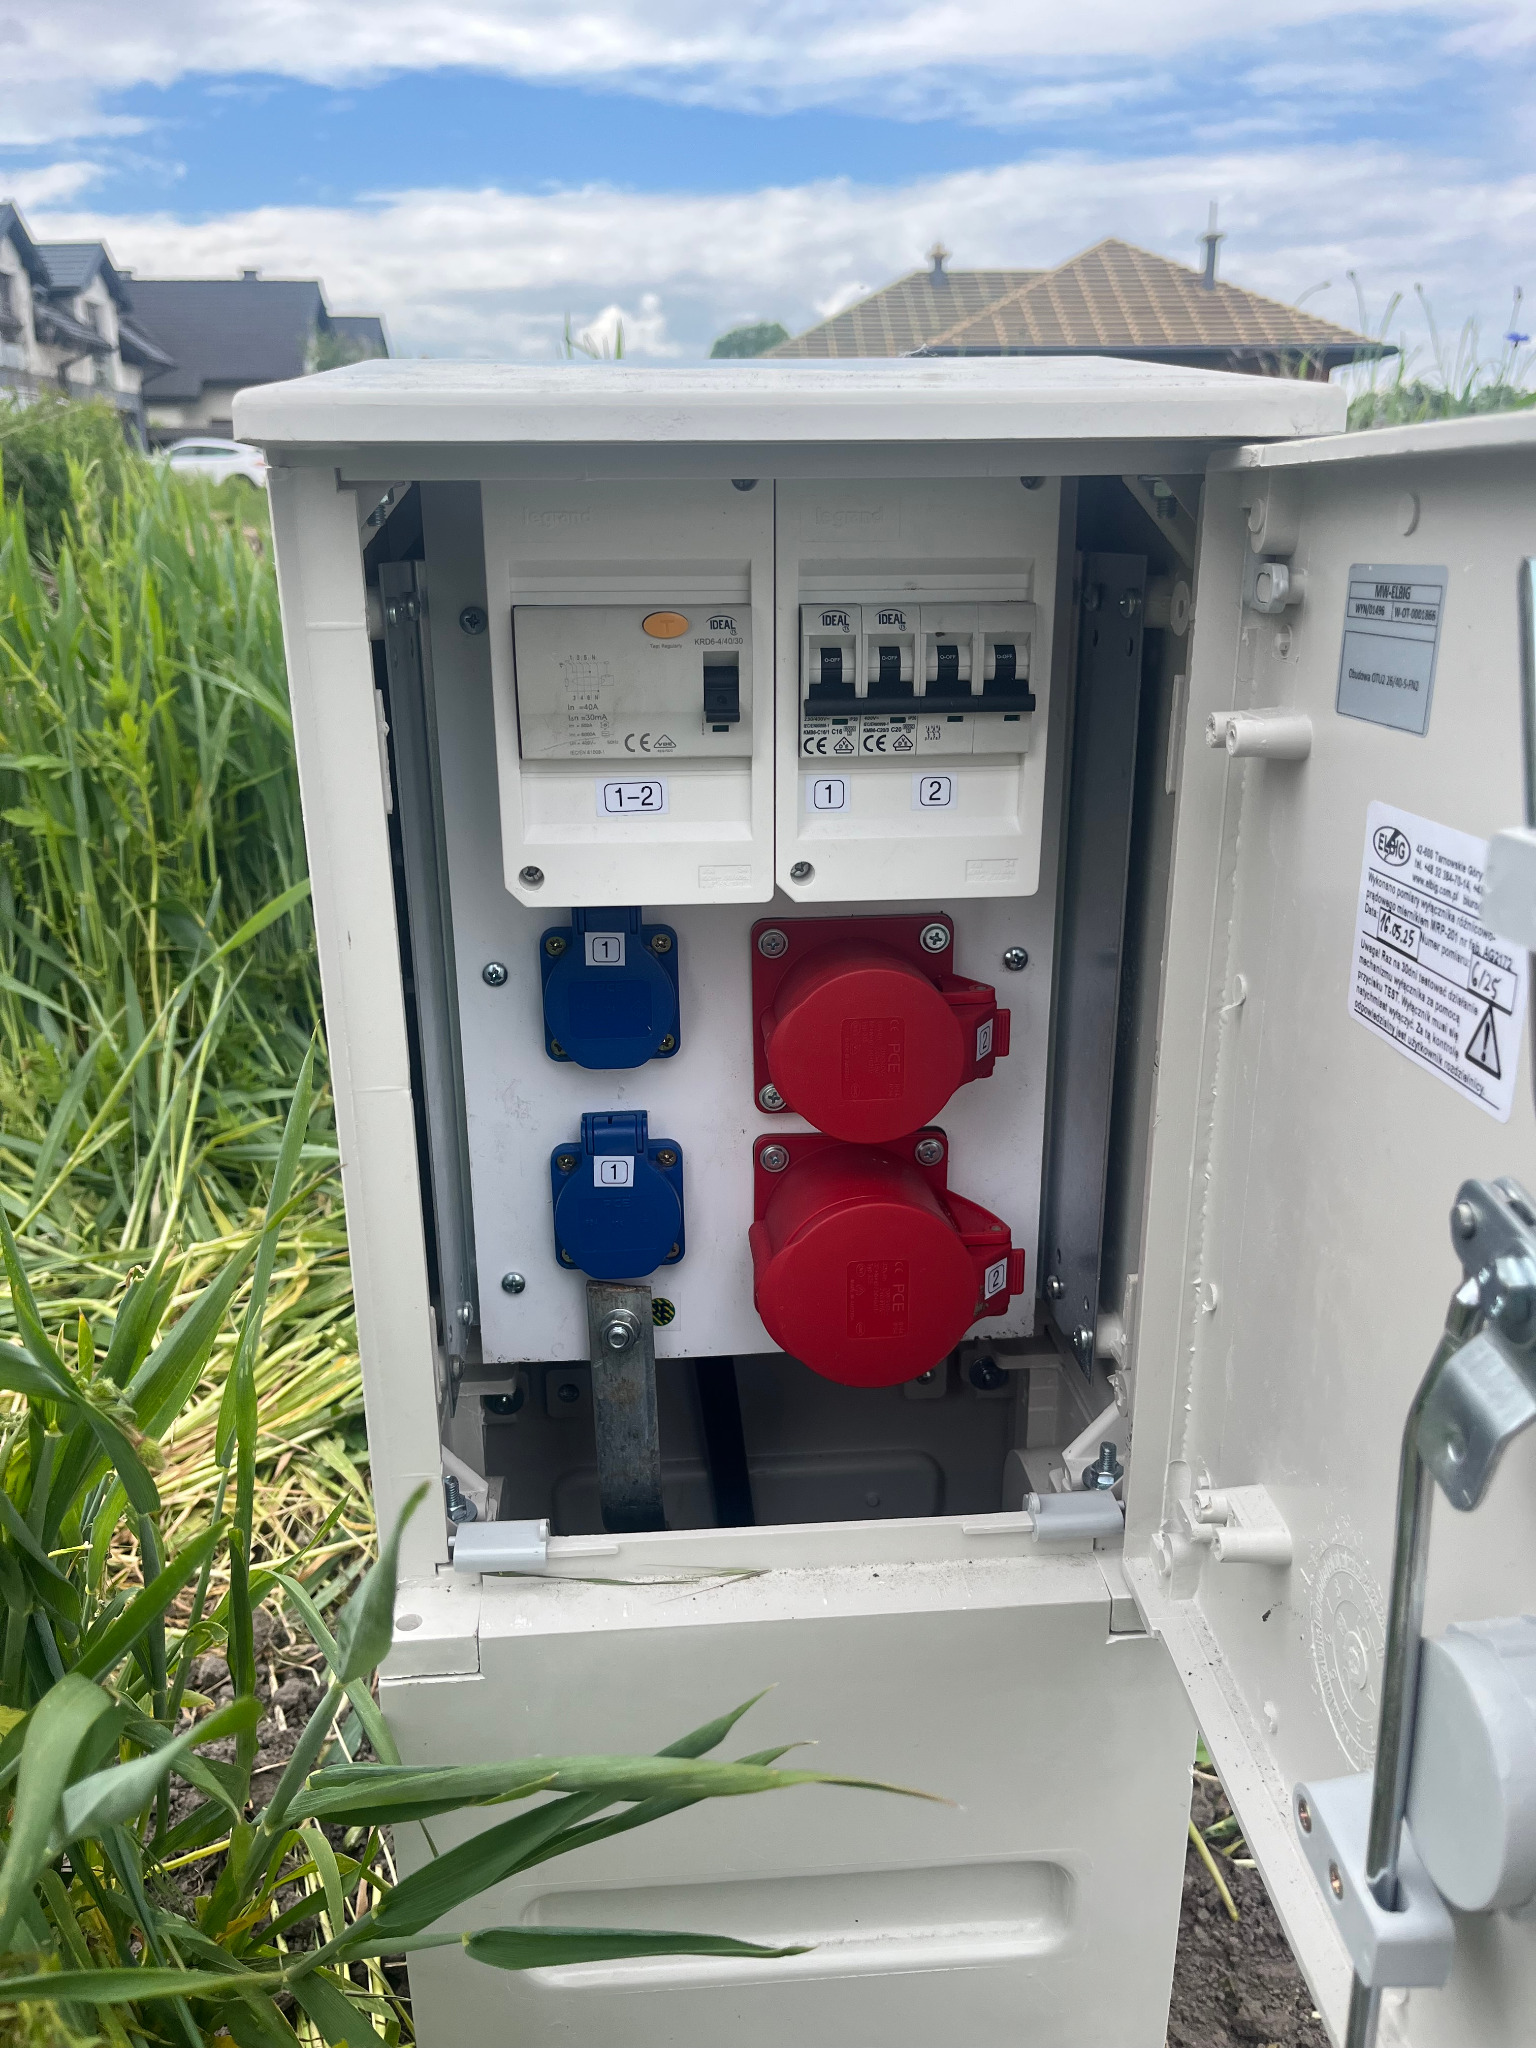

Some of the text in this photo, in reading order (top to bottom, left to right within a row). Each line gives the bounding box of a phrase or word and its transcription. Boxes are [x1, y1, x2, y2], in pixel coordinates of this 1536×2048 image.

[1374, 585, 1411, 600] MW-ELBIG
[660, 619, 675, 633] T
[710, 620, 736, 630] IDEAL
[822, 615, 849, 626] IDEAL
[879, 614, 906, 625] IDEAL
[614, 785, 654, 808] 1-2
[824, 784, 832, 804] 1
[929, 780, 942, 801] 2
[1378, 833, 1406, 860] ELBIG
[602, 940, 608, 959] 1
[888, 1043, 901, 1073] PCE
[610, 1164, 617, 1180] 1
[993, 1270, 1000, 1288] 2
[892, 1283, 905, 1312] PCE
